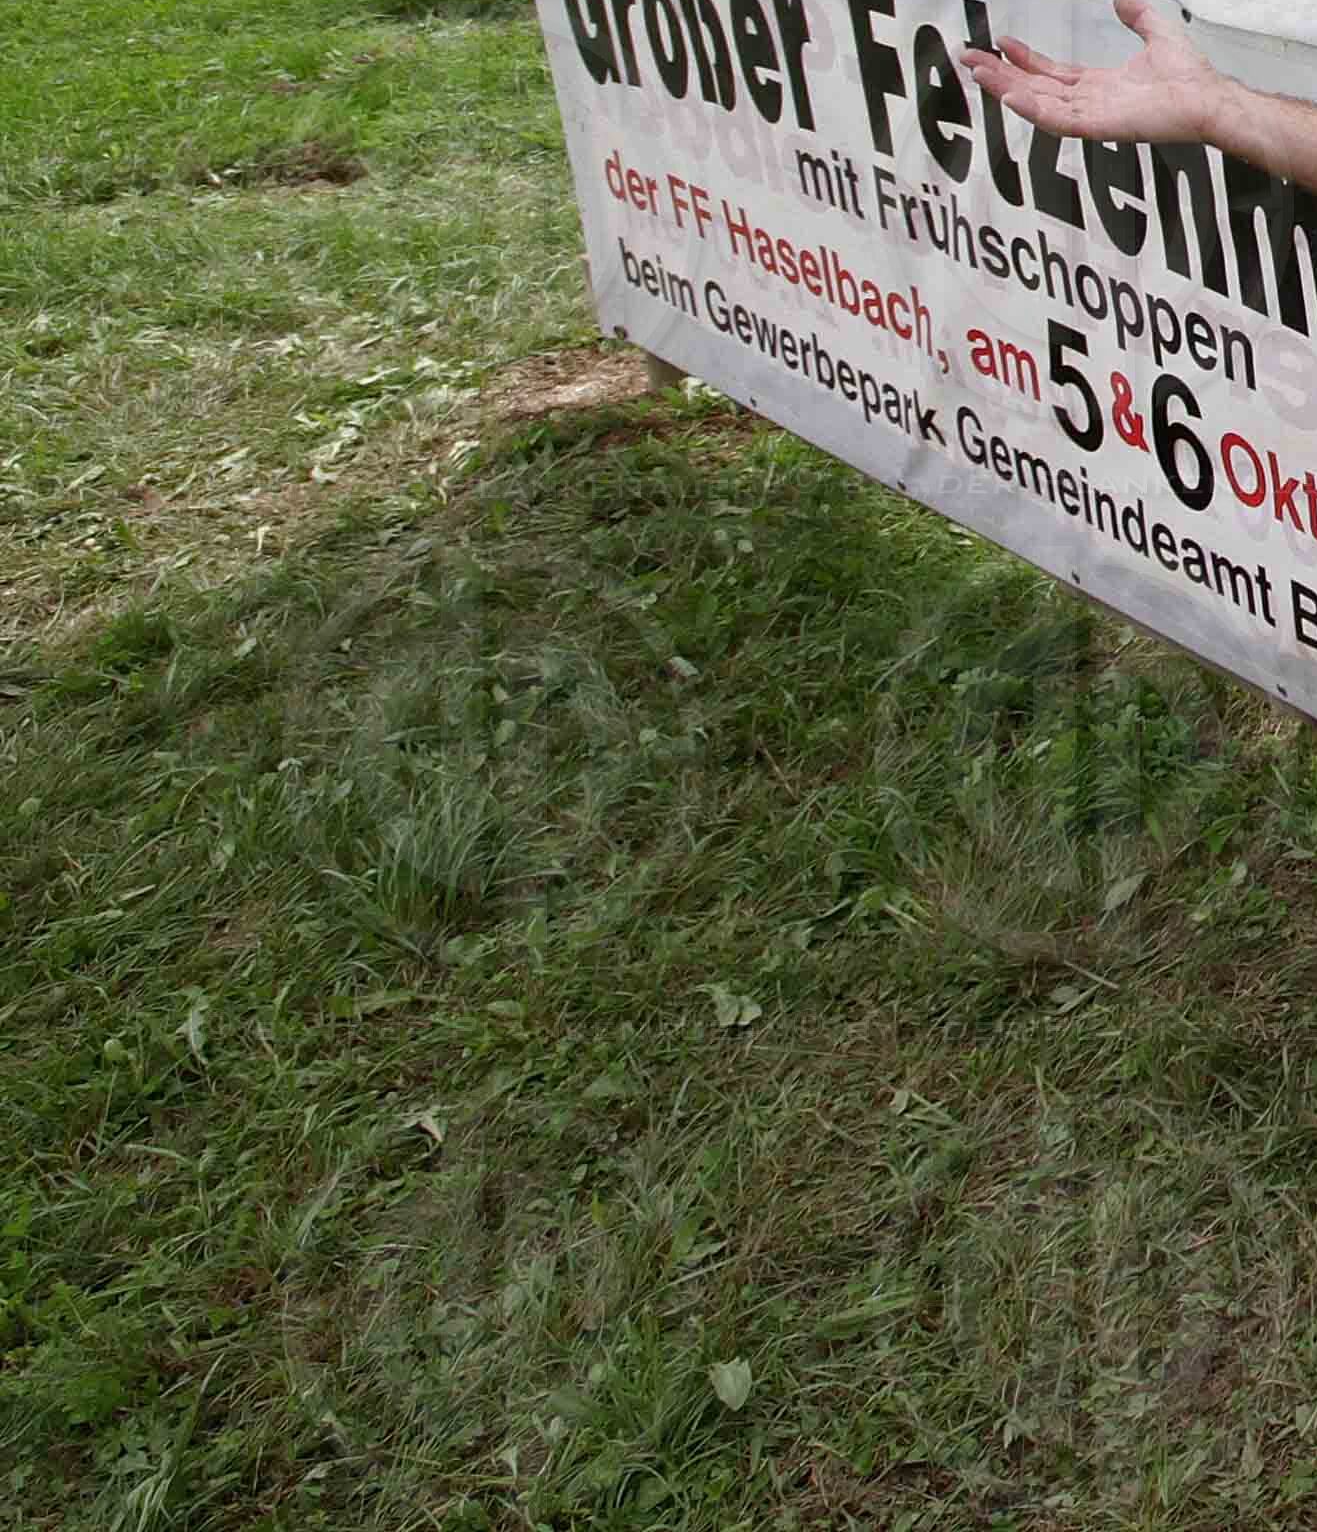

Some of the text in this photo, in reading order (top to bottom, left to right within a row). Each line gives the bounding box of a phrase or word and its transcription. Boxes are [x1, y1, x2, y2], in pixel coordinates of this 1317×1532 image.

[605, 149, 661, 216] der
[667, 172, 714, 240] FF
[721, 199, 952, 374] Haselbach,
[966, 327, 1042, 402] am
[1047, 318, 1104, 453] 5
[1110, 371, 1150, 454] &
[1150, 372, 1215, 512] 6
[617, 236, 699, 319] beim
[705, 280, 946, 448] Gewerbepark
[956, 406, 1276, 629] Gemeindeamt
[796, 148, 1257, 391] mit Frühschoppen
